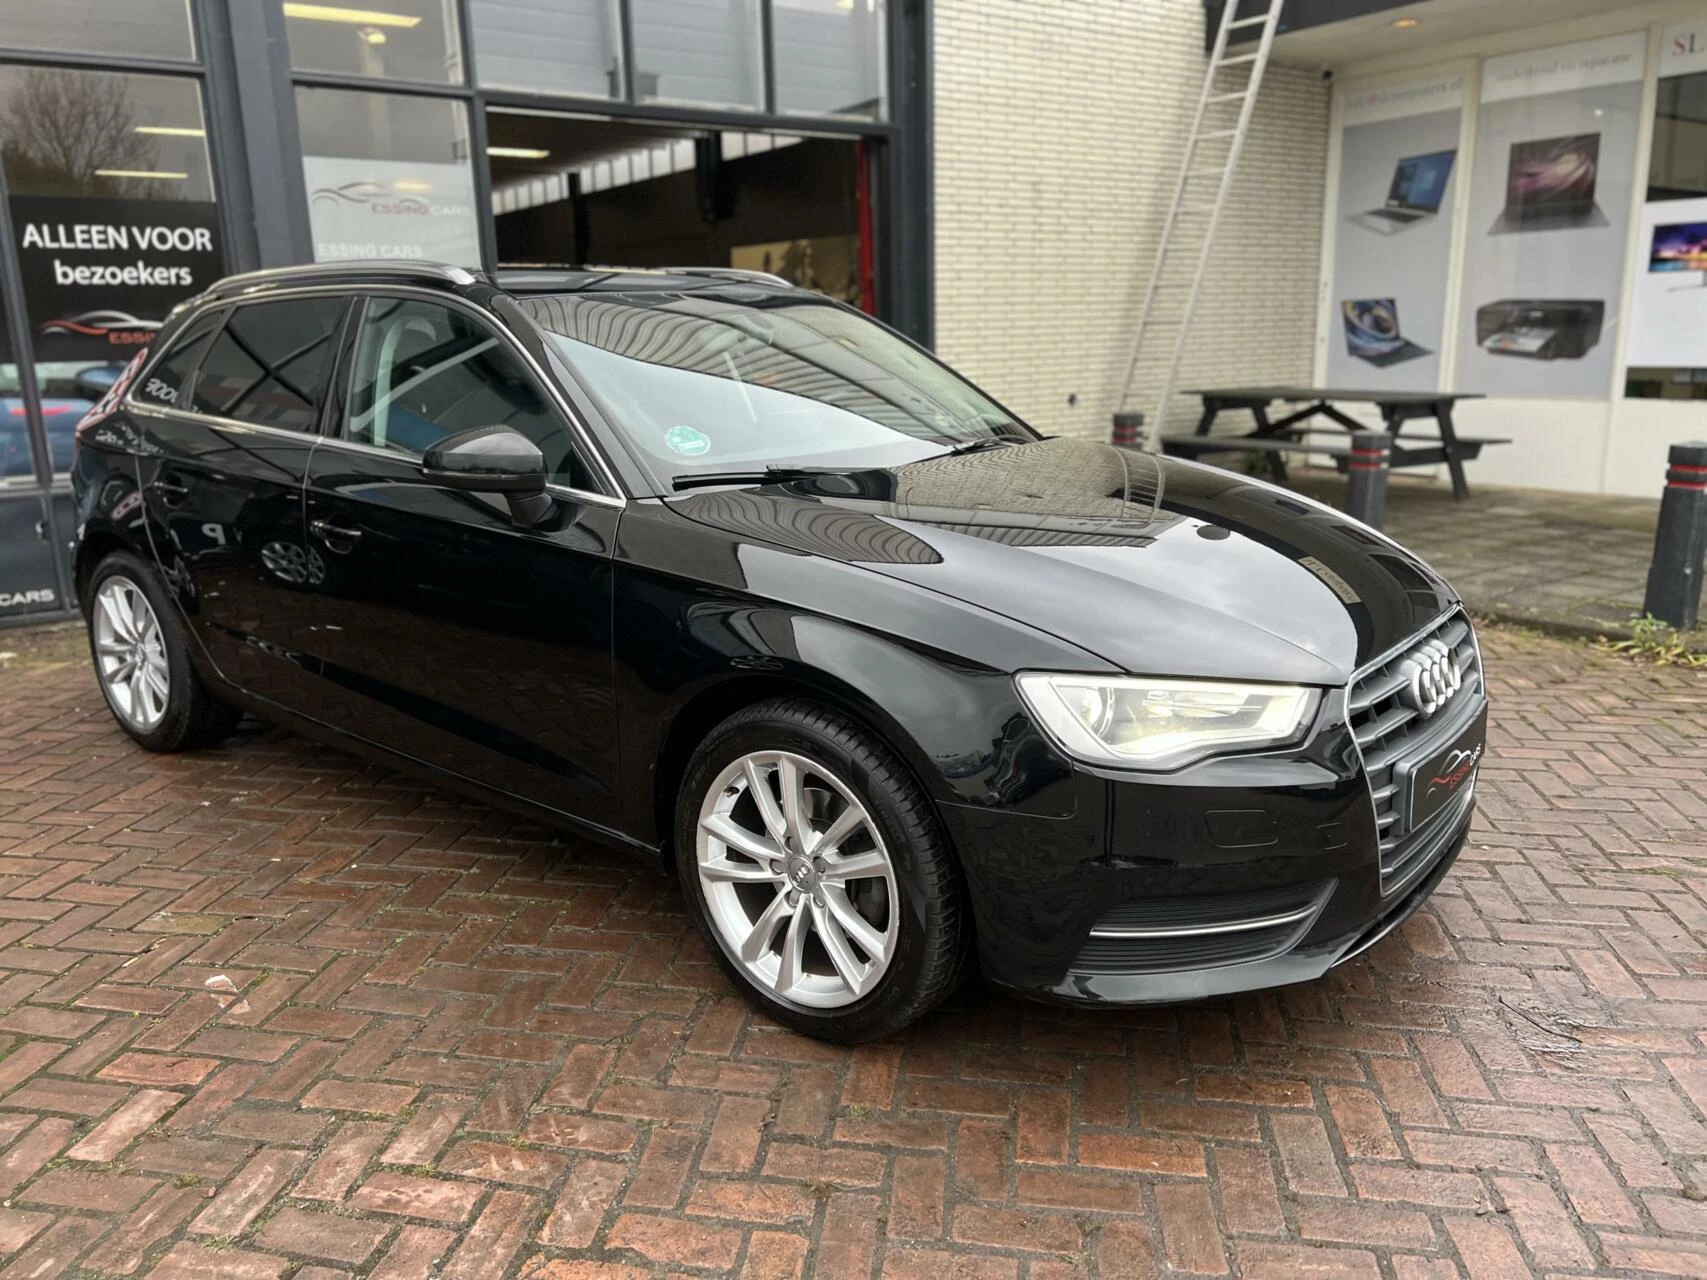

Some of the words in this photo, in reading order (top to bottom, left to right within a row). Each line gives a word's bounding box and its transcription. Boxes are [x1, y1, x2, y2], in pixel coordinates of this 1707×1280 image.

[371, 202, 429, 216] ESSING
[22, 223, 129, 250] ALLEEN
[131, 225, 213, 251] VOOR
[317, 242, 377, 258] ESSING
[380, 244, 424, 259] CARS
[53, 259, 193, 286] bezoekers
[0, 588, 55, 607] CARS
